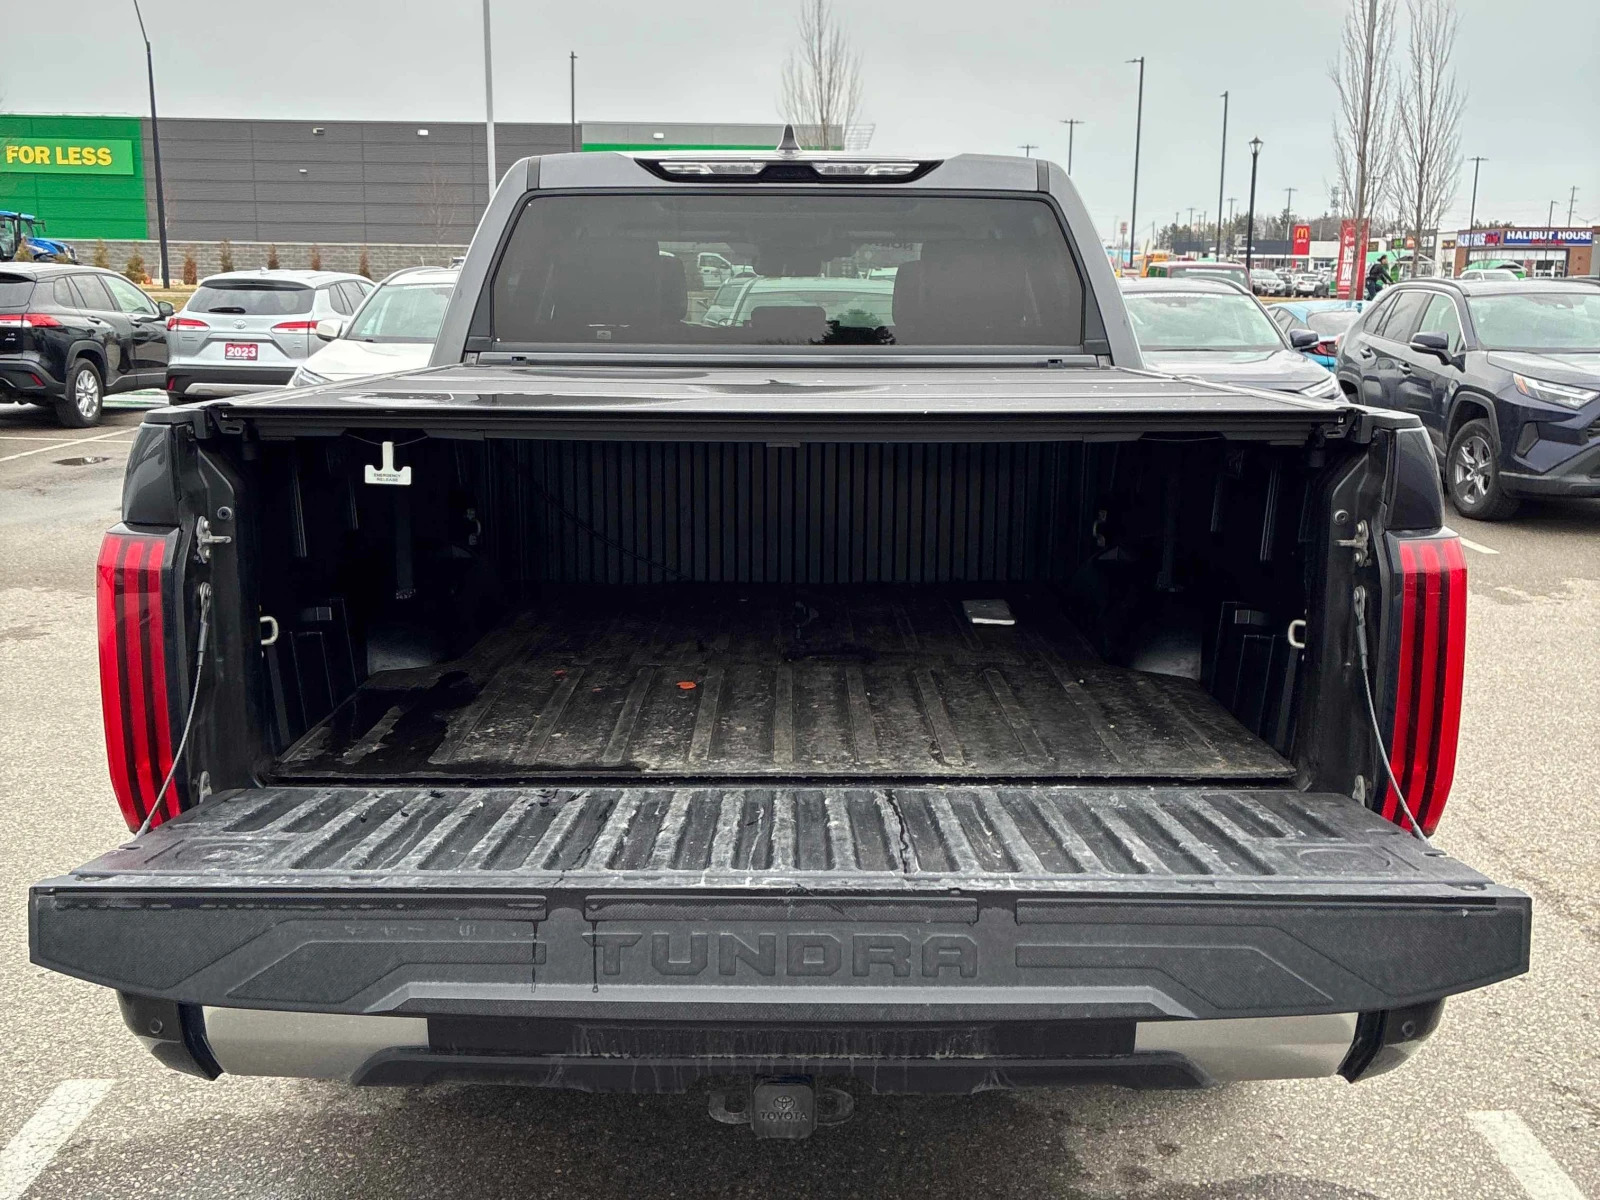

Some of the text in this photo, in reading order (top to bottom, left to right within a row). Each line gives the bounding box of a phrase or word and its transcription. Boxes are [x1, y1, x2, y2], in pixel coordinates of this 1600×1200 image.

[6, 145, 113, 166] FOR LESS
[1506, 230, 1593, 240] HALIBUT HOUSE
[226, 347, 256, 357] 2023
[582, 932, 978, 978] TUNDRA
[760, 1111, 808, 1121] TOYOTA
